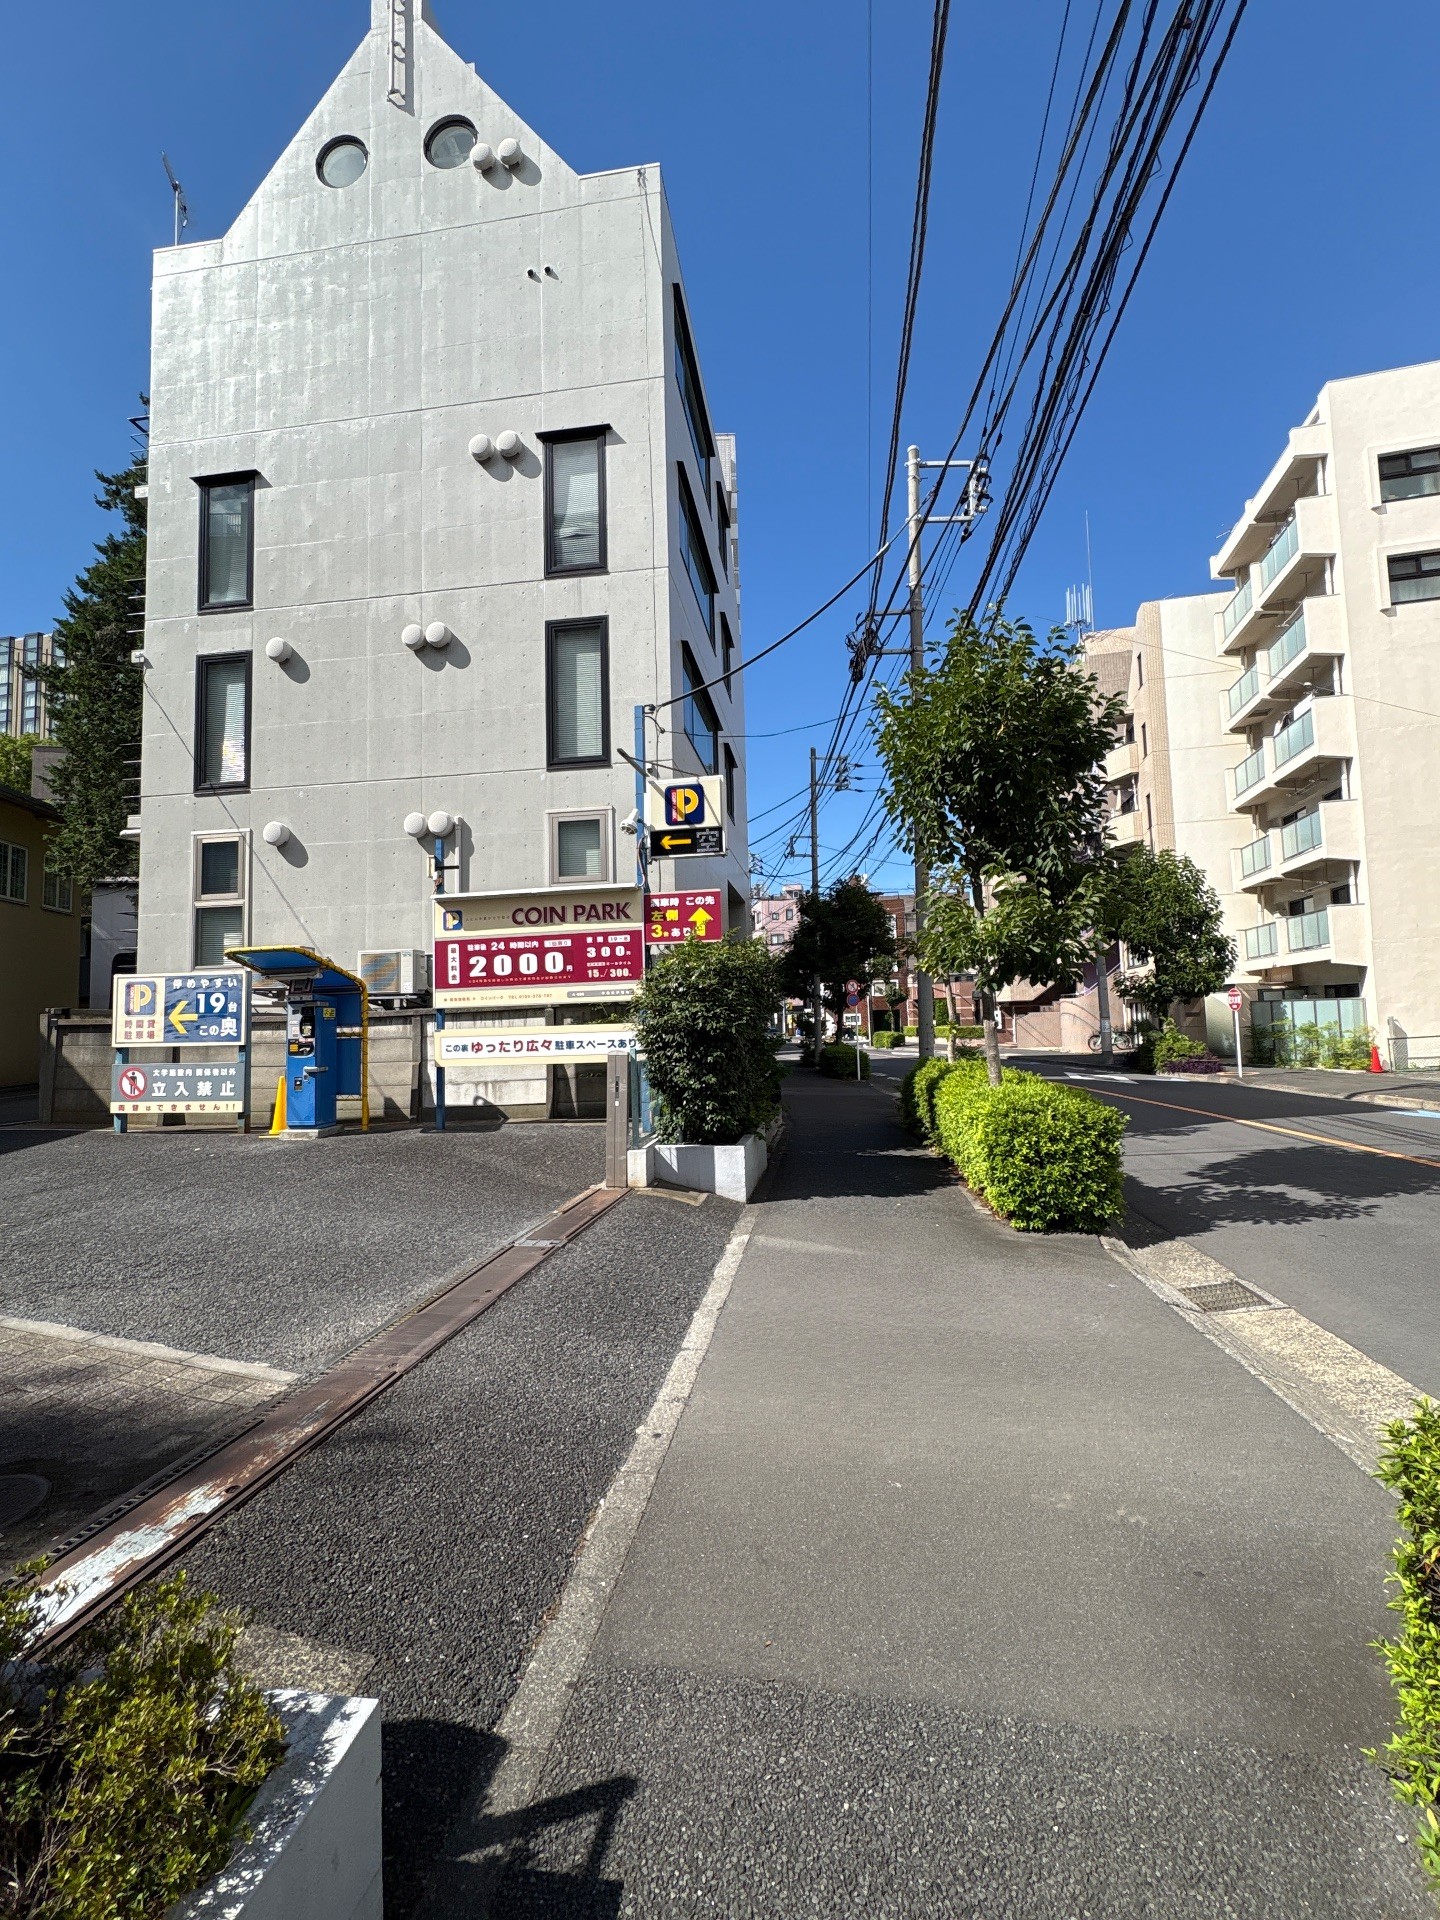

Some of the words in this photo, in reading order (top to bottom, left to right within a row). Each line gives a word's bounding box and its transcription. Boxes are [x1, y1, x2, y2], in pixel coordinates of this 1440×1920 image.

[686, 895, 715, 906] この先
[511, 905, 567, 926] COIN
[573, 901, 632, 922] PARK
[490, 941, 505, 951] 24
[468, 951, 573, 978] 2000円
[172, 978, 238, 990] 停めやすい
[199, 1016, 238, 1037] この奥
[151, 1081, 236, 1097] 立入禁止
